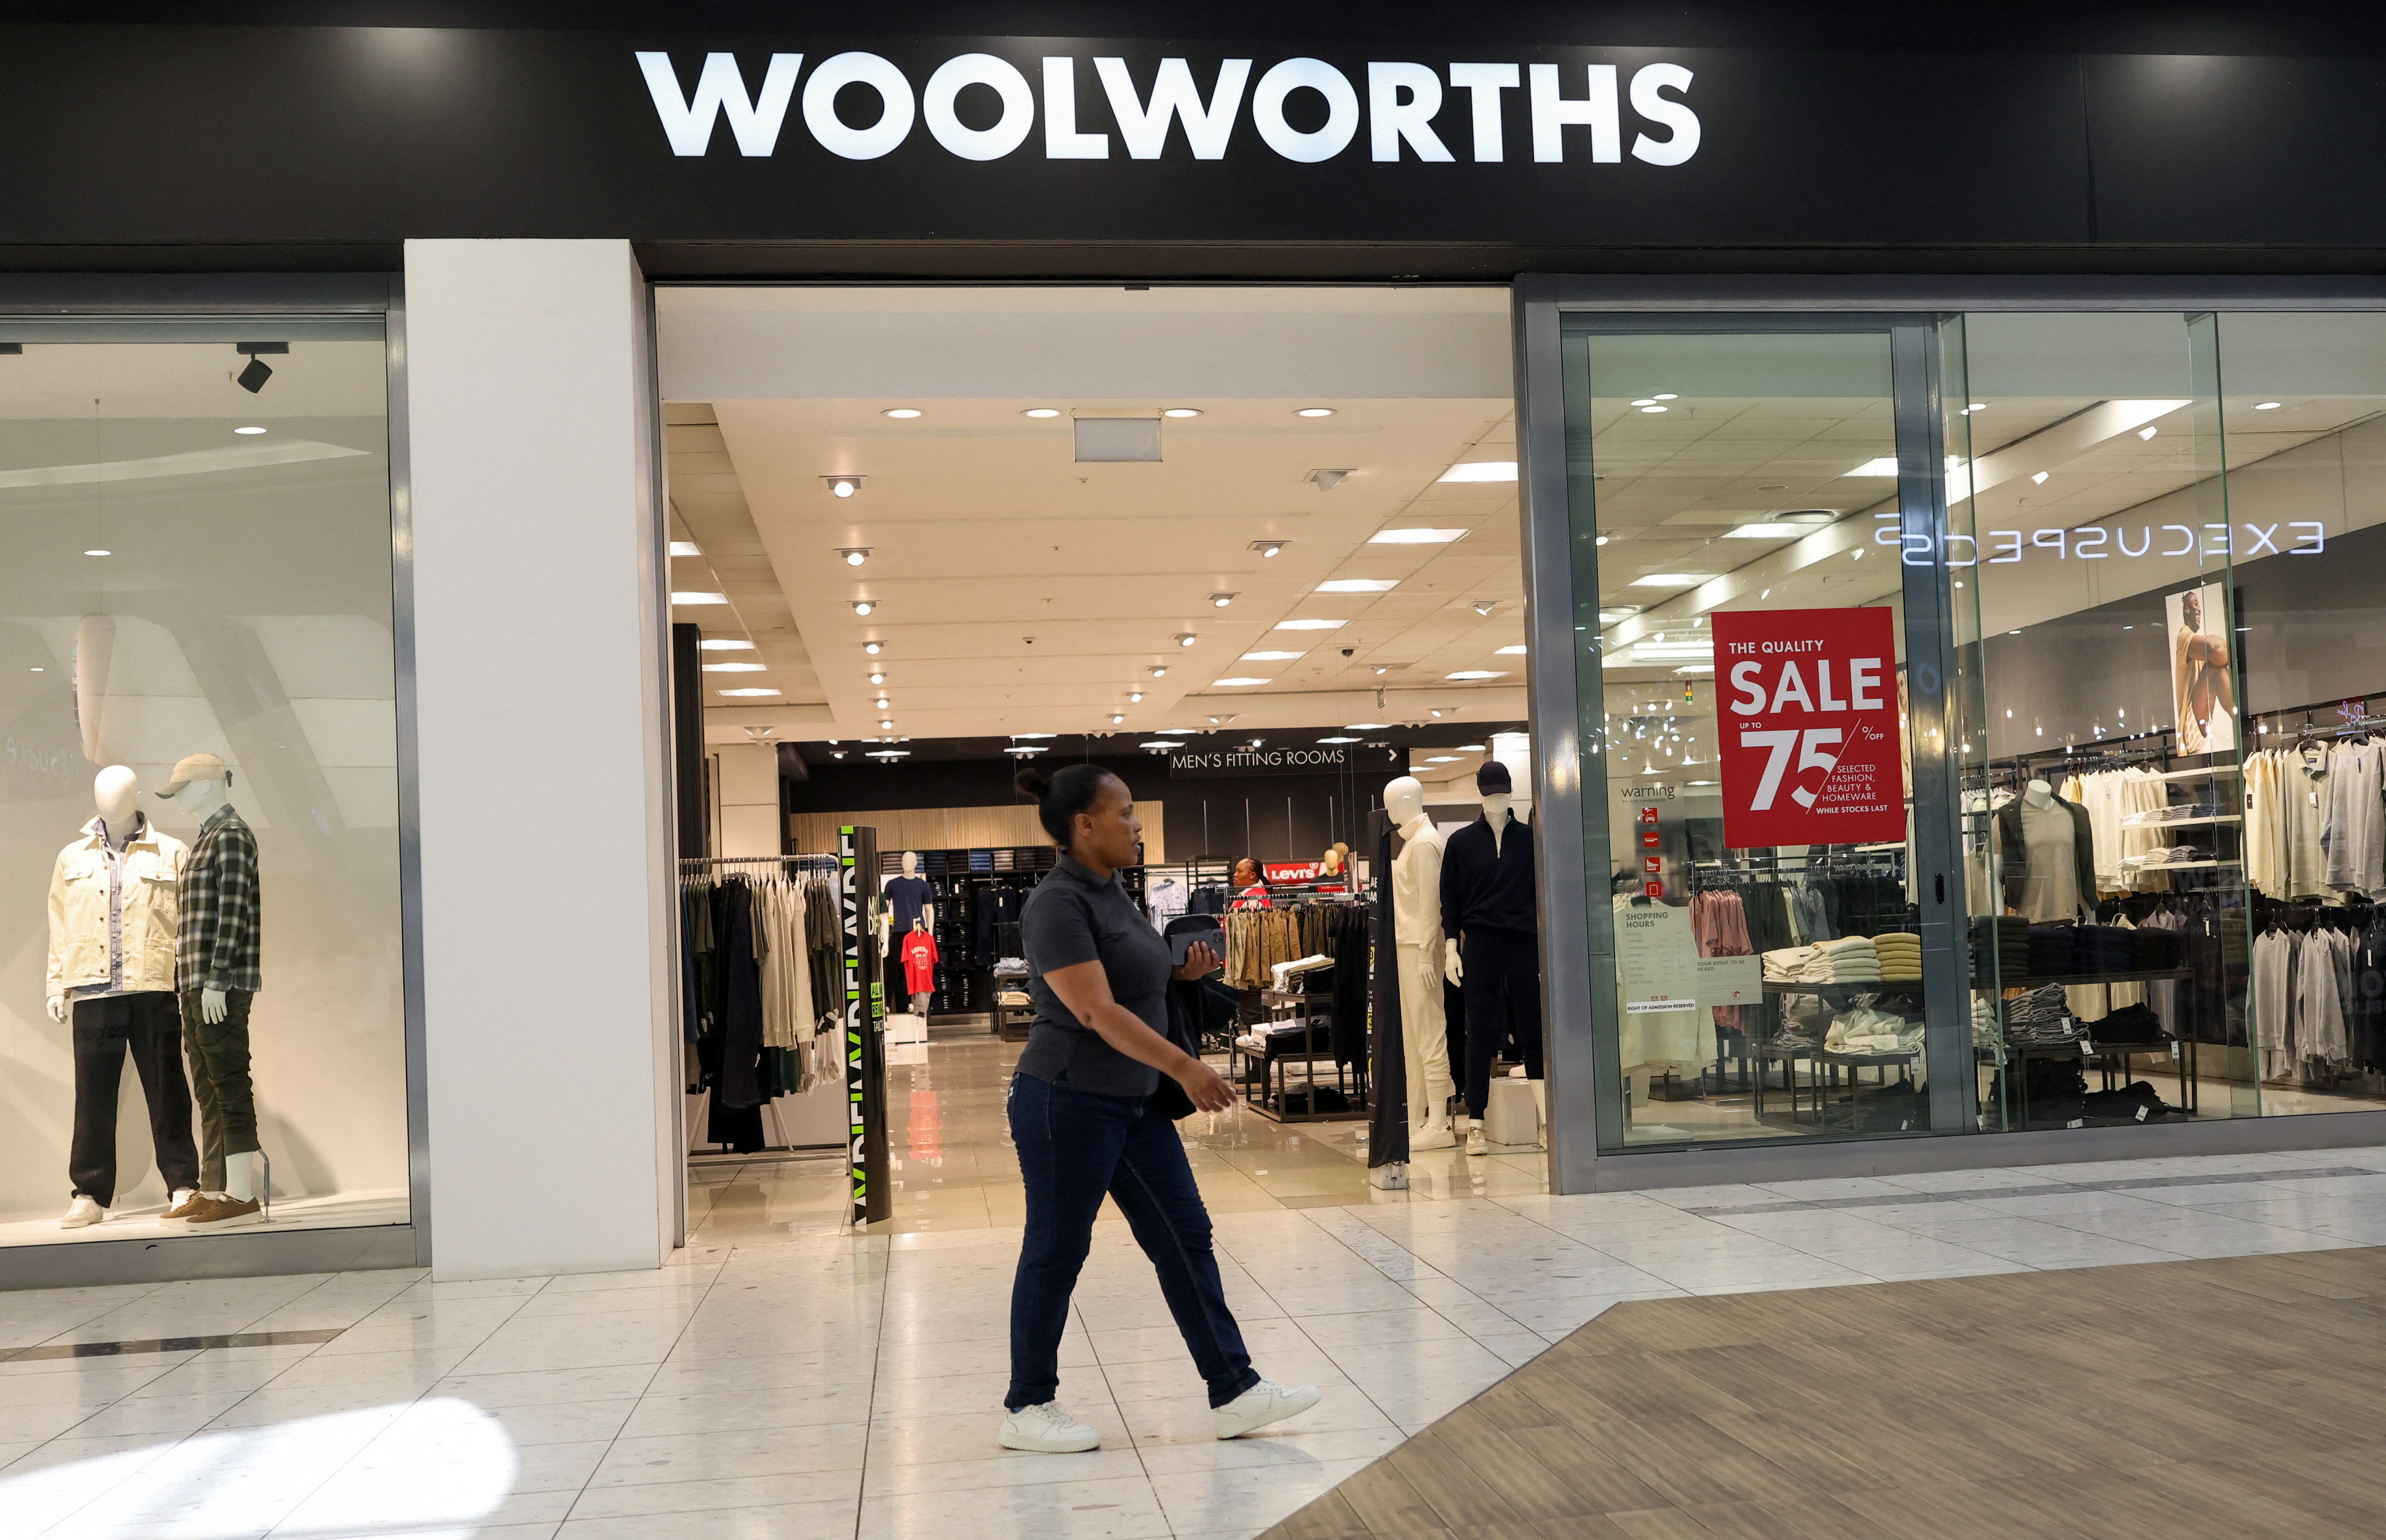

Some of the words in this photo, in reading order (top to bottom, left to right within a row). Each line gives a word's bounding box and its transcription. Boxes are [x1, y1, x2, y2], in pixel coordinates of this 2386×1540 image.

[636, 52, 1700, 166] WOOLWORTHS
[1729, 642, 1756, 654] THE
[1762, 640, 1824, 654] QUALITY
[1730, 658, 1883, 716] SALE
[1173, 753, 1221, 769] MEN'S
[1226, 751, 1281, 767] FITTING
[1287, 749, 1344, 765] ROOMS
[1740, 727, 1842, 811] 75
[1837, 764, 1875, 773] SELECTED
[1832, 774, 1875, 783] FASHION,
[1621, 786, 1675, 799] warning
[1827, 784, 1861, 793] BEAUTY
[1865, 783, 1871, 791] &
[1822, 792, 1876, 802] HOMEWARE
[1626, 912, 1668, 920] SHOPPING
